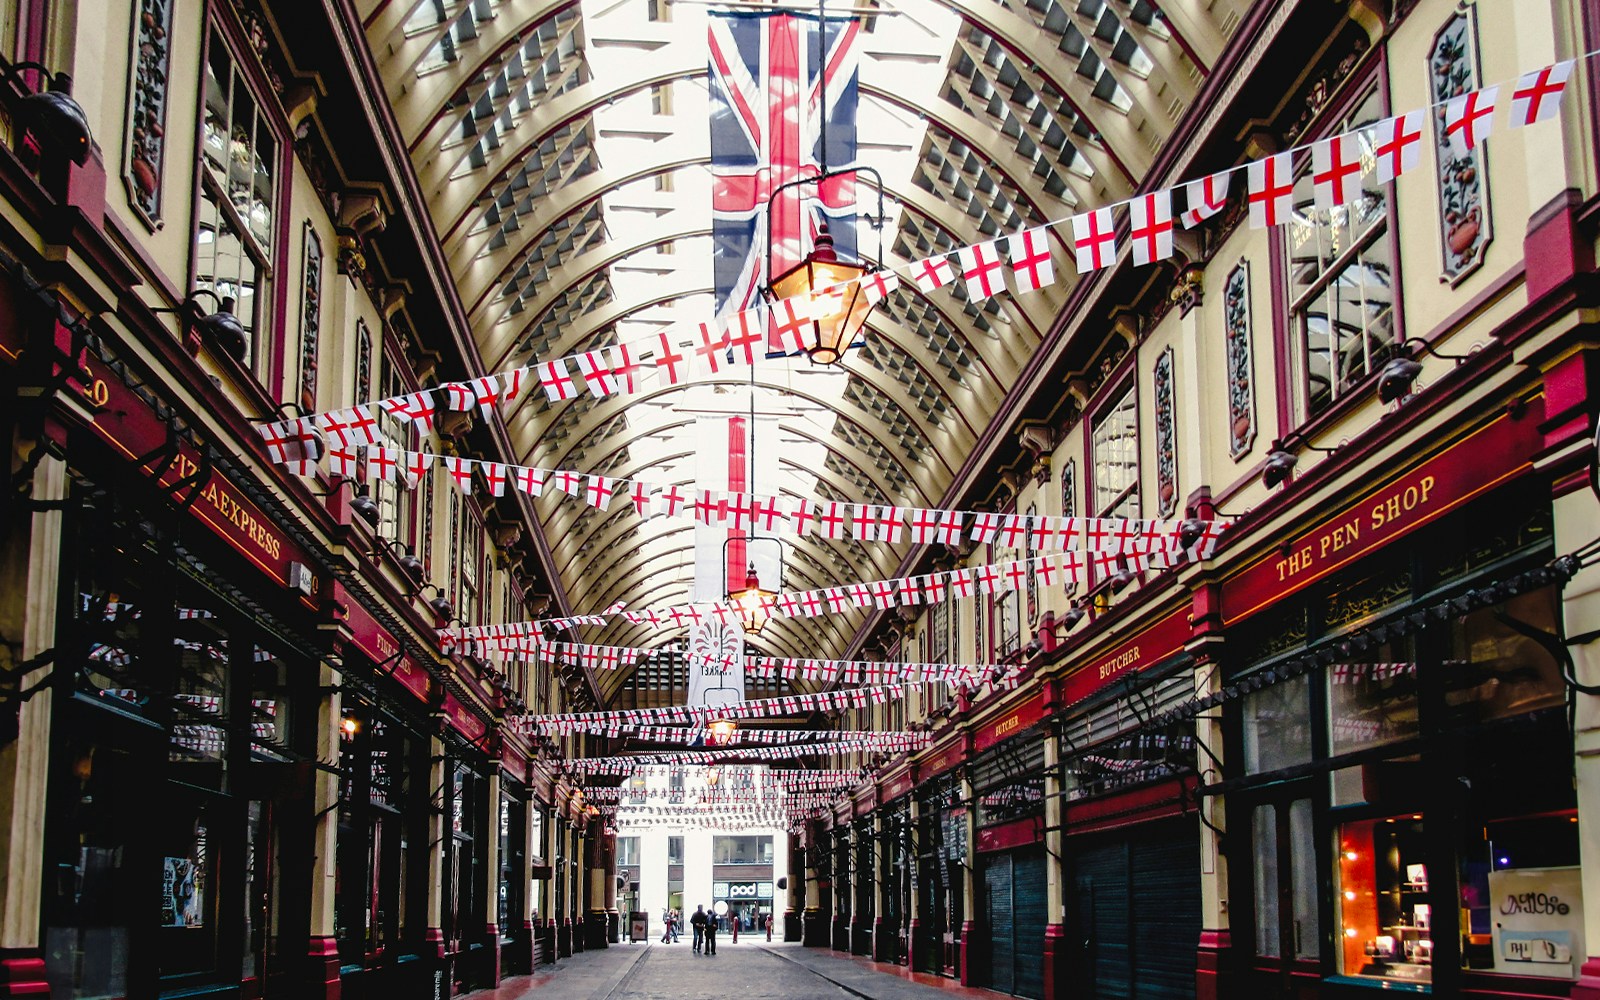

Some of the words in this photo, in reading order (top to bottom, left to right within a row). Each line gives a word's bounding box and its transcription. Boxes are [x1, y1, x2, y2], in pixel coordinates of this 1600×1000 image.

[1276, 545, 1313, 582] THE
[1320, 518, 1360, 559] PEN
[1371, 475, 1436, 530] SHOP
[1099, 646, 1141, 680] BUTCHER
[995, 715, 1019, 737] BUTCHER
[730, 882, 757, 898] pod
